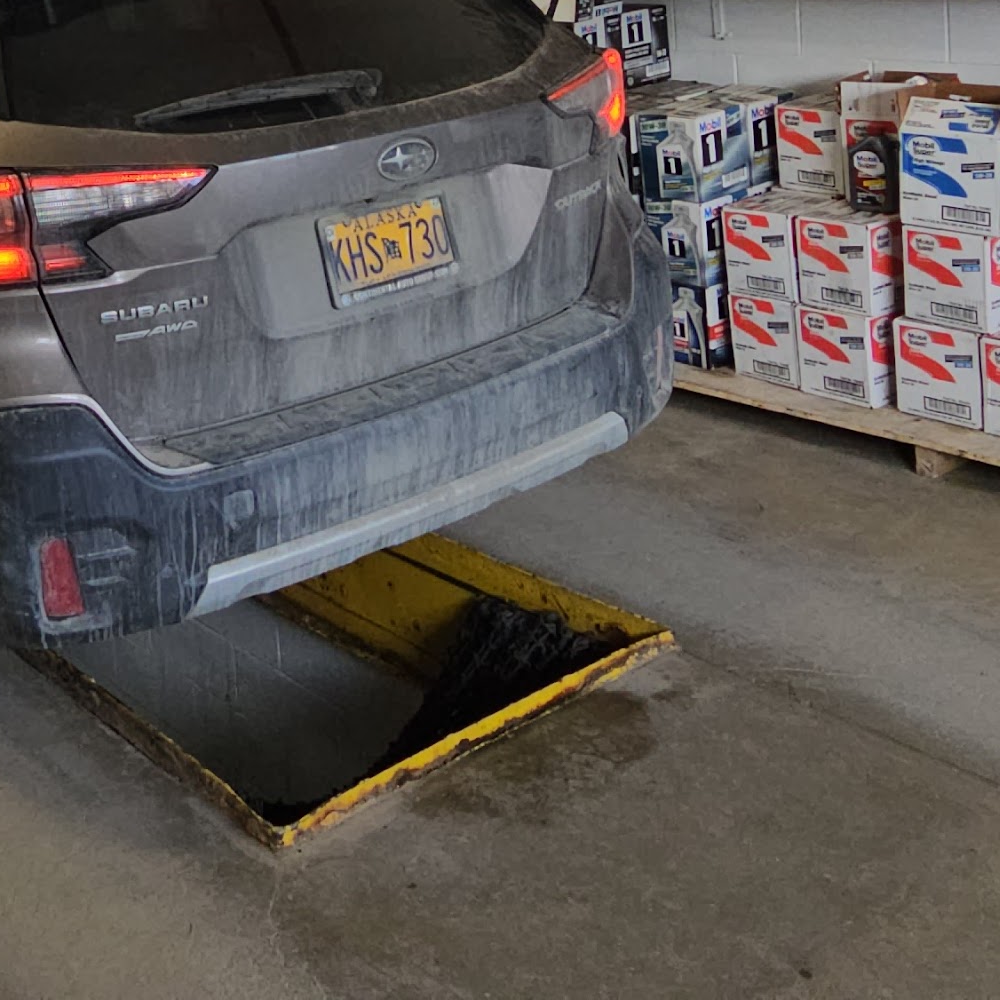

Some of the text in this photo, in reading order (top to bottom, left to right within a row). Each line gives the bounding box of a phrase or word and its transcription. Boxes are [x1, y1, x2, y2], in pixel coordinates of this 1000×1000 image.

[631, 23, 640, 43] 1
[752, 103, 775, 118] Mobil
[699, 116, 721, 131] Mobil
[758, 119, 768, 148] 1
[706, 133, 717, 164] 1
[912, 140, 936, 150] Mobil
[913, 148, 936, 156] Super
[668, 158, 677, 175] 1
[856, 154, 877, 162] Mobil
[353, 203, 418, 232] ALASKA
[328, 214, 450, 283] KHS 730
[672, 240, 681, 257] 1
[101, 296, 208, 325] SUBARU
[147, 320, 198, 338] AWD
